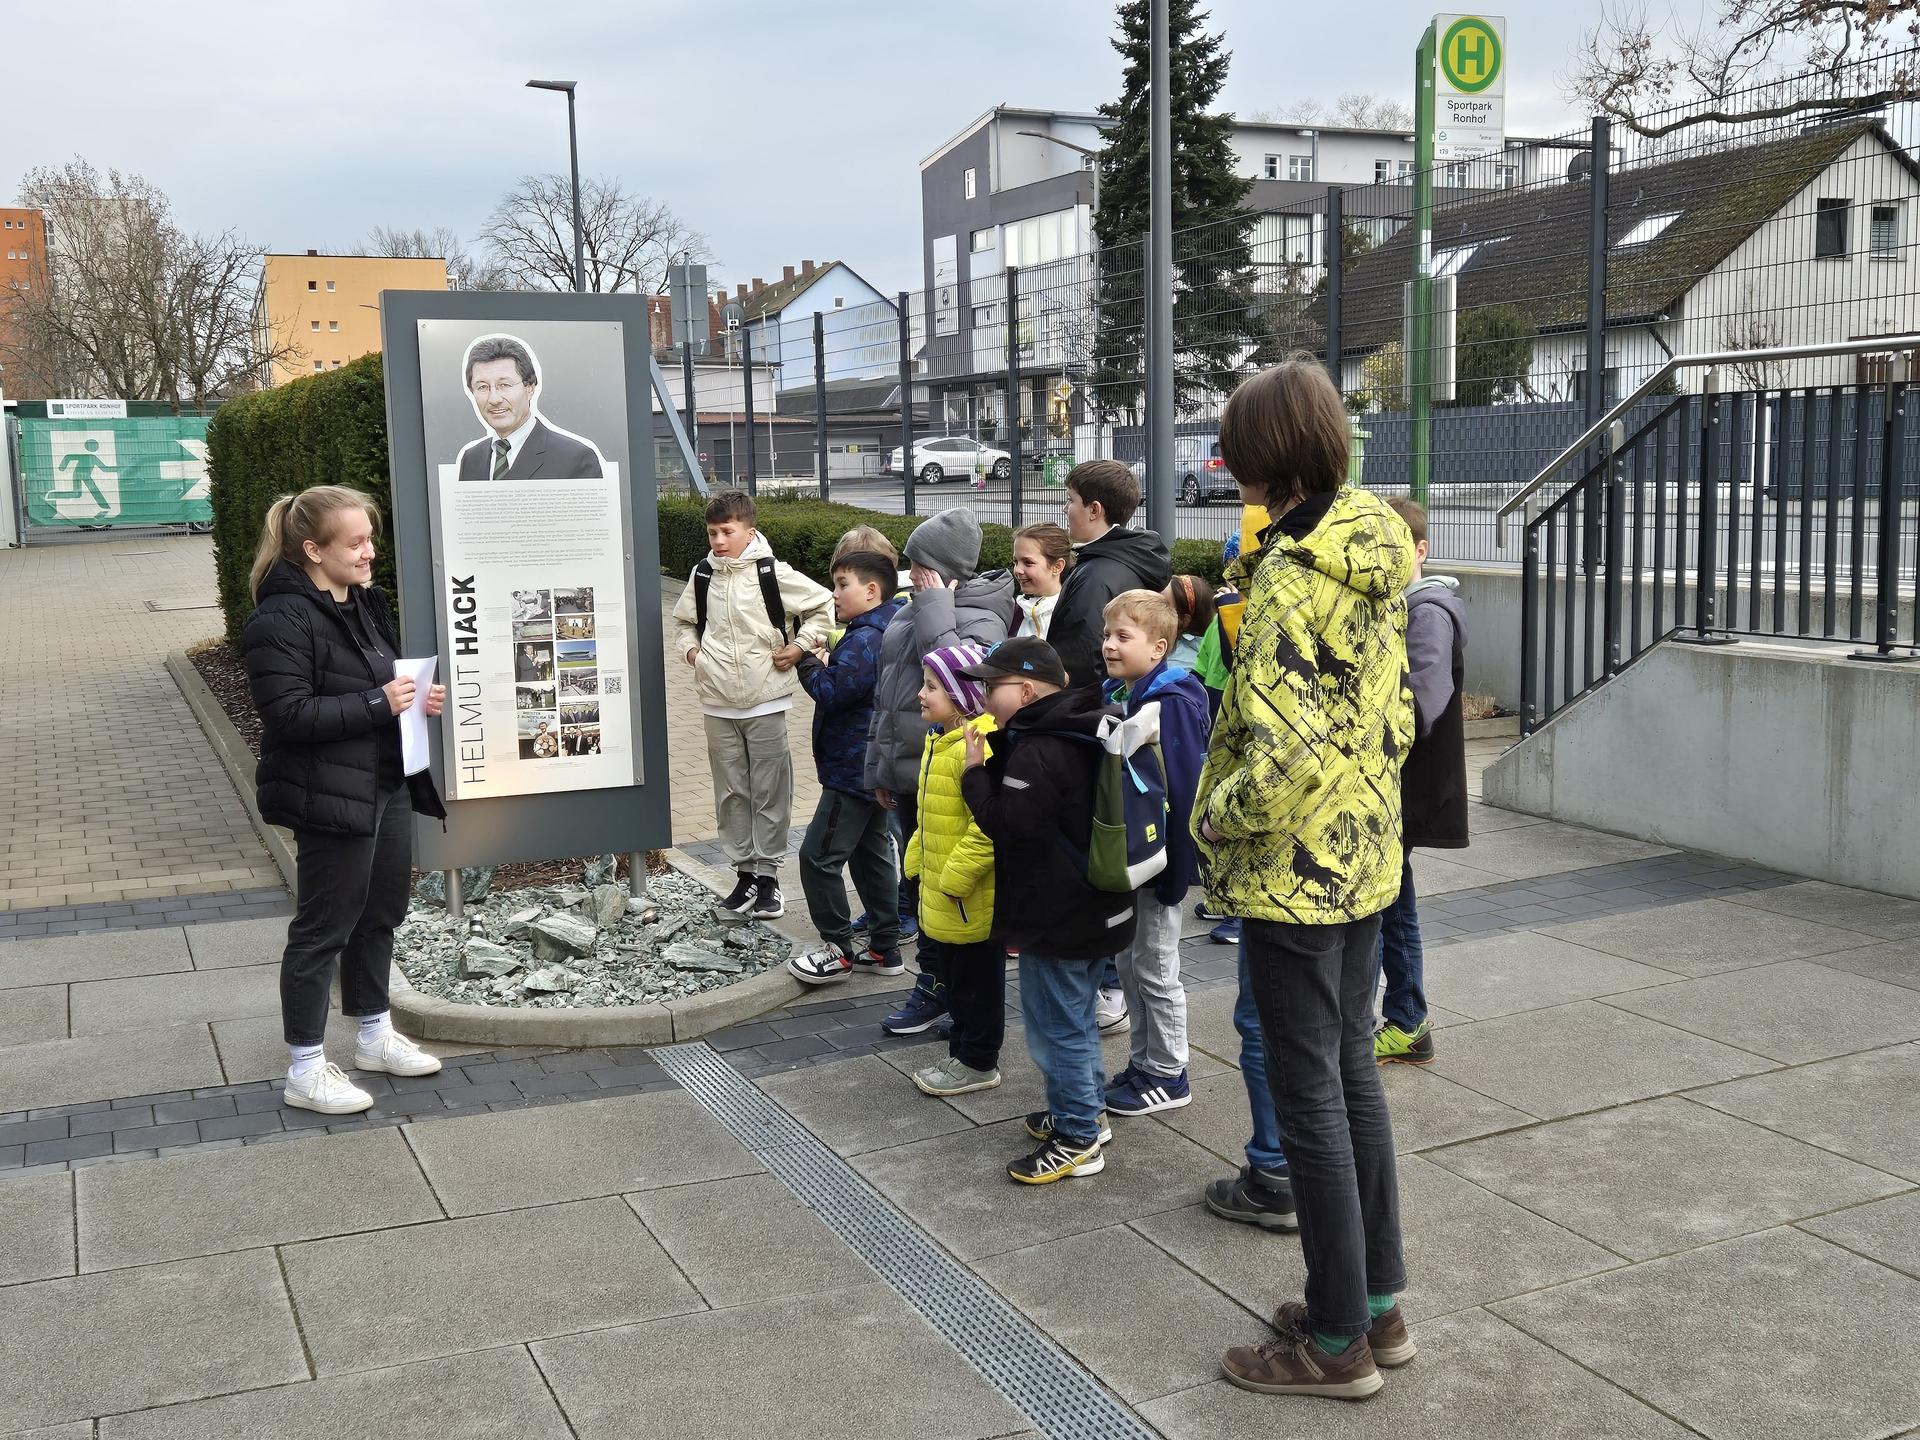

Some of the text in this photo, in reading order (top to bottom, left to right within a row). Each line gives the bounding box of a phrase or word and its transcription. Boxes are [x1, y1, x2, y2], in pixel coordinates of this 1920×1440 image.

[1457, 35, 1485, 75] H
[1447, 99, 1493, 112] Sportpark
[1453, 113, 1487, 124] Ronhof
[451, 575, 486, 784] HELMUT HACK
